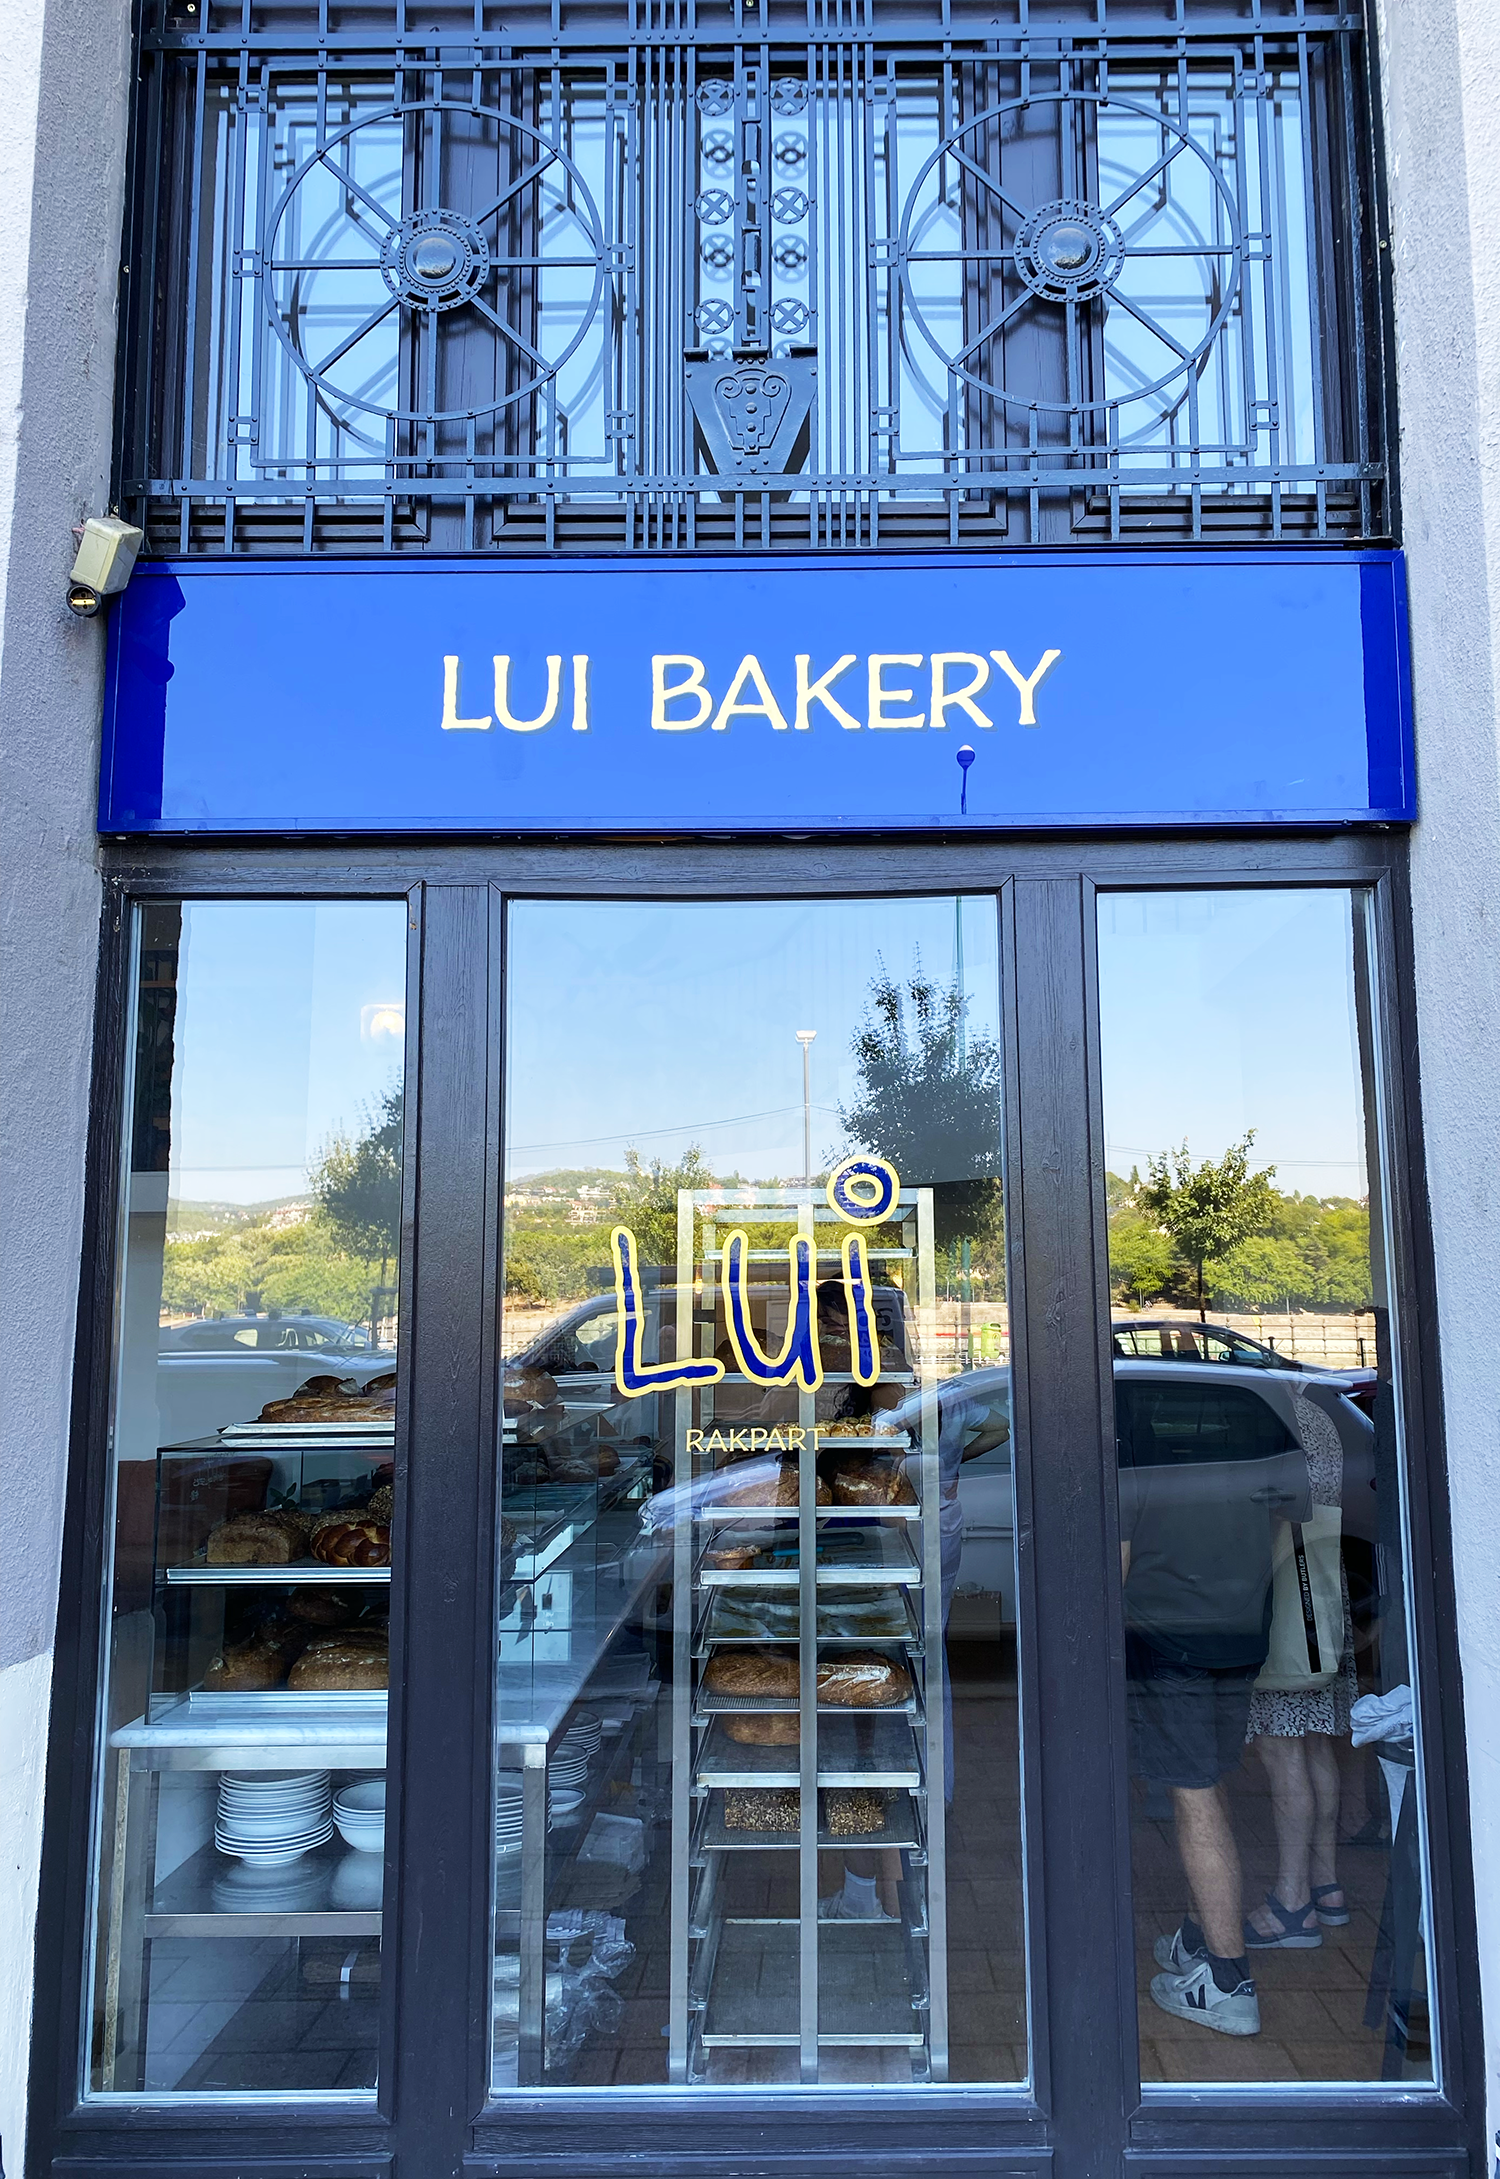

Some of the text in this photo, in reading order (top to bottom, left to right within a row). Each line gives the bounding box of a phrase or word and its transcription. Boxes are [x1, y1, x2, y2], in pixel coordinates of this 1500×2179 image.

[441, 648, 1062, 732] LUI BAKERY
[685, 1427, 826, 1453] RAKPART
[1302, 1582, 1309, 1591] BY
